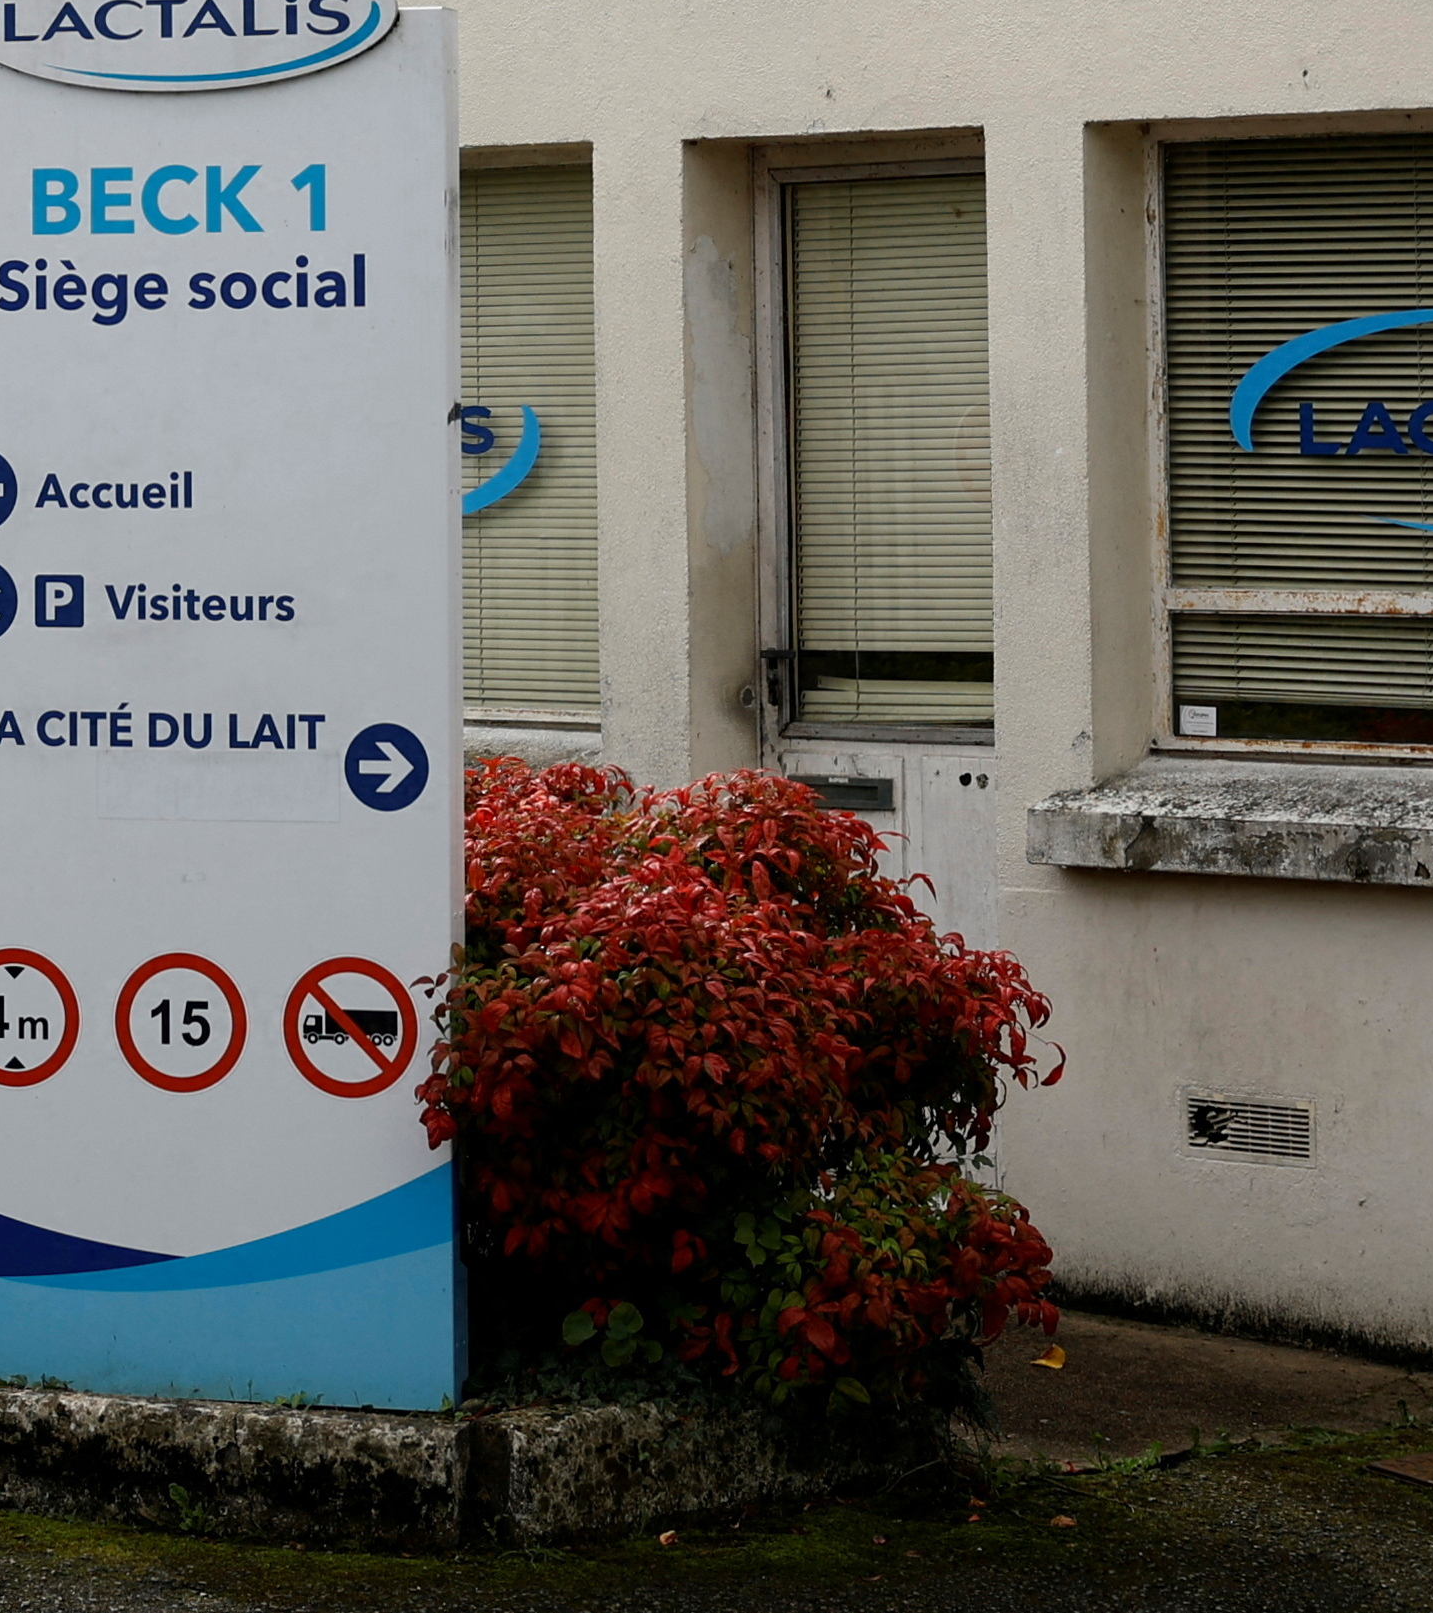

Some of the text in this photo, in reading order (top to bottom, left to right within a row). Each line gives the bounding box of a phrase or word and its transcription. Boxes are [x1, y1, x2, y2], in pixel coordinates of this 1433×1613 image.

[31, 163, 328, 236] BECK 1
[188, 253, 366, 310] social
[35, 471, 194, 510] Accueil
[106, 583, 296, 623] Visiteurs
[36, 702, 132, 749] CITÉ
[148, 713, 213, 749] DU
[228, 713, 326, 750] LAIT
[150, 999, 211, 1047] 15
